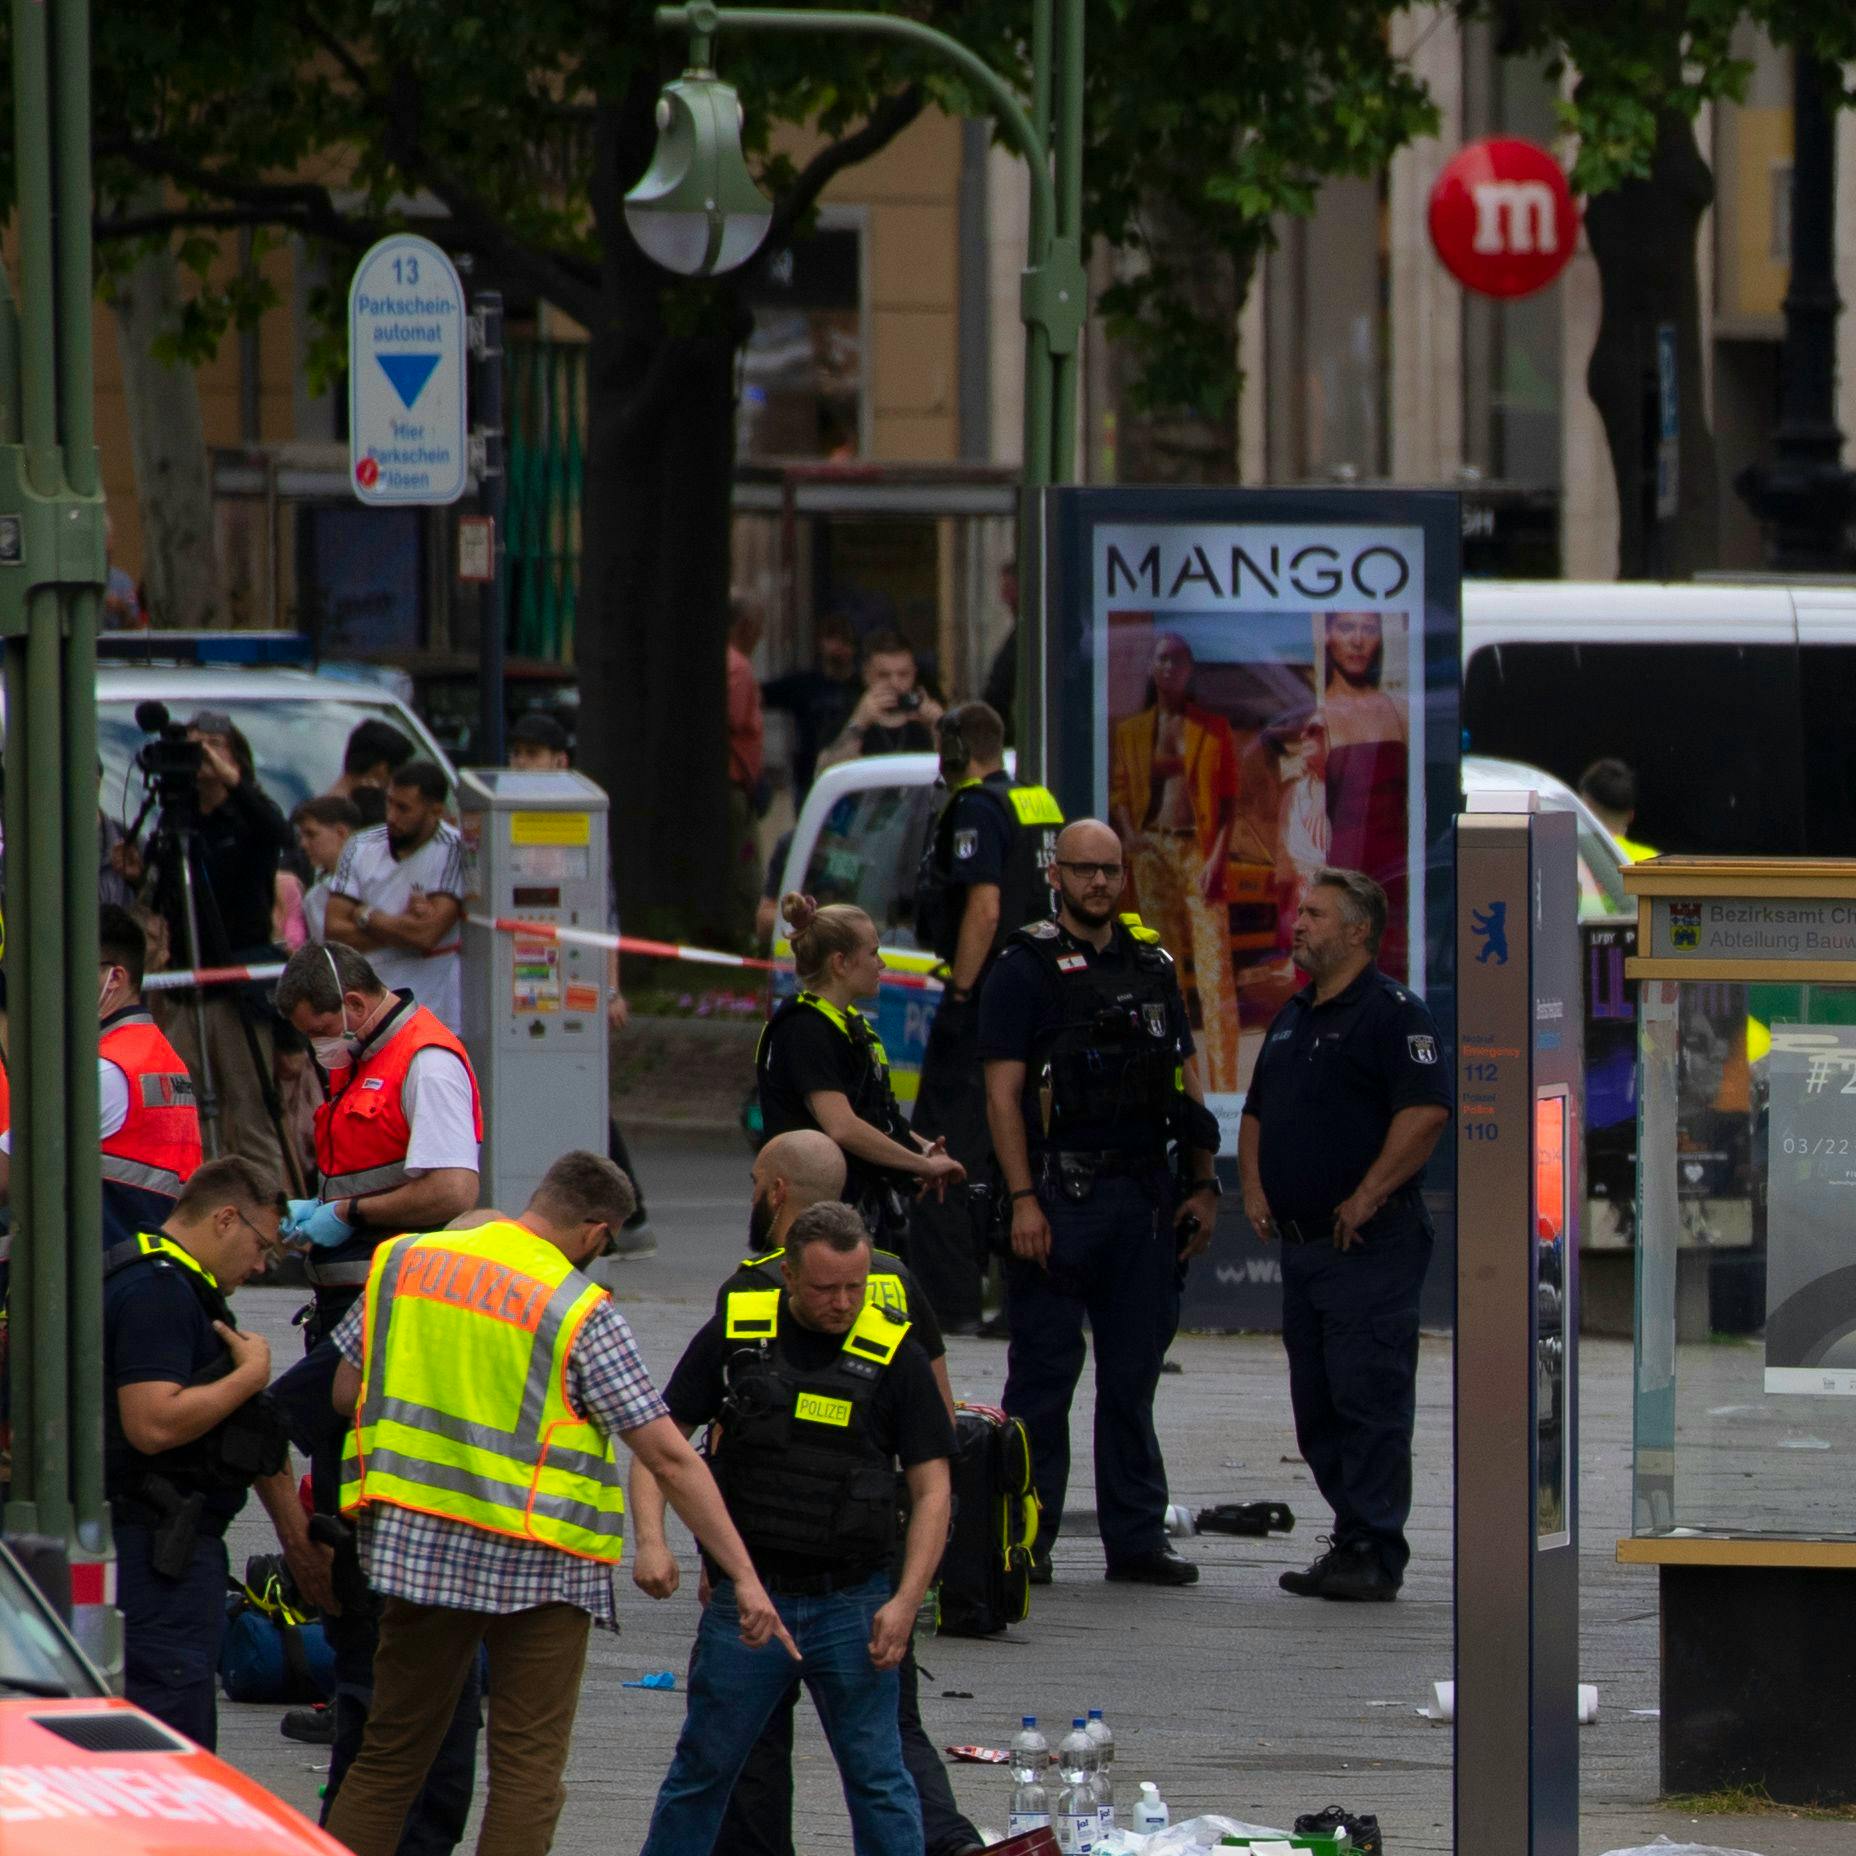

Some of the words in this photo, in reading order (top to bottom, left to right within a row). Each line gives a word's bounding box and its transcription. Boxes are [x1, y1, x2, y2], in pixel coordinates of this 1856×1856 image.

[1474, 181, 1555, 254] m
[392, 256, 420, 285] 13
[358, 296, 457, 316] Parkschein-
[373, 324, 442, 343] automat
[393, 423, 424, 440] Hier
[368, 448, 450, 464] Parkschein
[1107, 544, 1410, 600] MANGO
[1710, 906, 1824, 924] Bezirksamt
[1710, 932, 1799, 952] Abteilung
[1463, 1046, 1521, 1058] Emergency
[1464, 1064, 1499, 1082] 112
[1464, 1123, 1499, 1141] 110
[1783, 1138, 1849, 1155] 03/22
[404, 1248, 545, 1325] POLIZEI
[800, 1398, 847, 1421] POLIZEI
